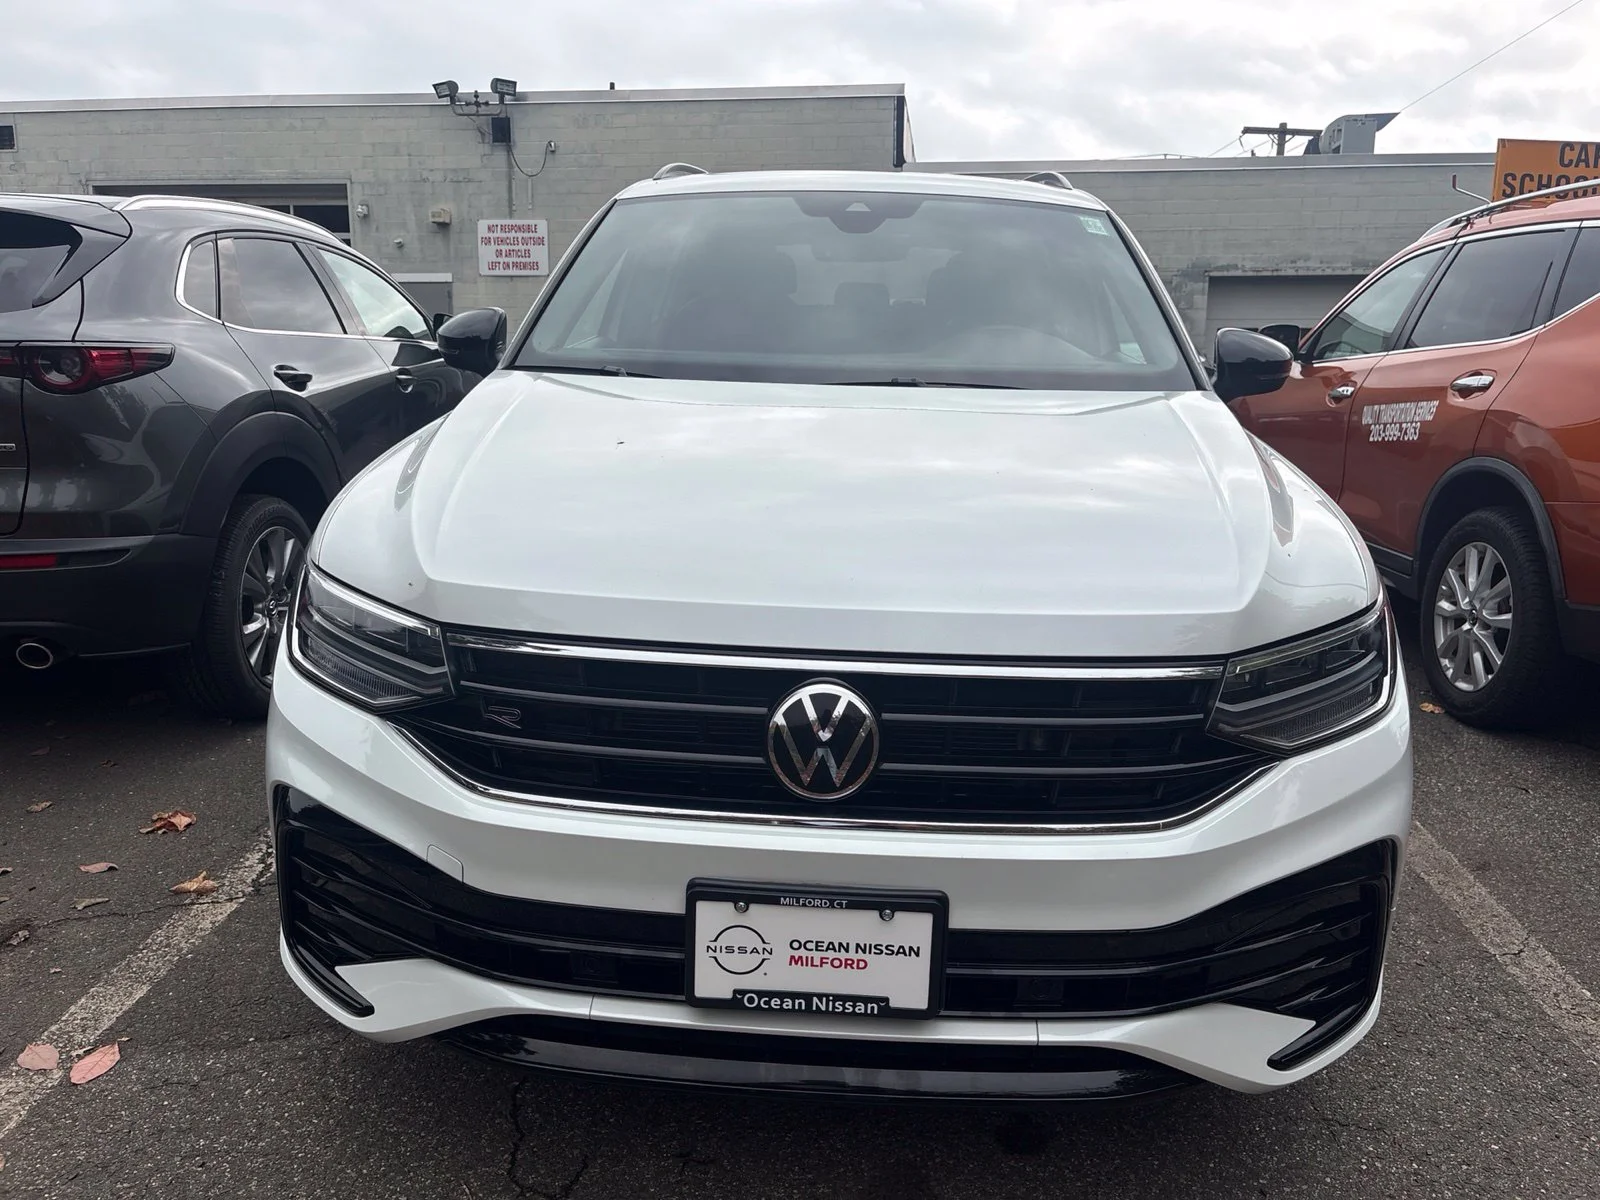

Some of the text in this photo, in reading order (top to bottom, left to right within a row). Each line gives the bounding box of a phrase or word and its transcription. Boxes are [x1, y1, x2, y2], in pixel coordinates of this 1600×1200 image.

[487, 224, 538, 234] NOT RESPONSIBLE
[481, 236, 545, 246] FOR VEHICLES OUTSIDE
[495, 249, 531, 258] OR ARTICLES
[488, 261, 539, 271] LEFT ON PREMISES
[1369, 422, 1420, 442] 203-999-7363
[834, 900, 848, 909] CT
[706, 944, 773, 956] NISSAN
[789, 939, 921, 958] OCEAN NISSAN
[788, 954, 868, 971] MILFORD
[743, 993, 878, 1015] Ocean Nissan
